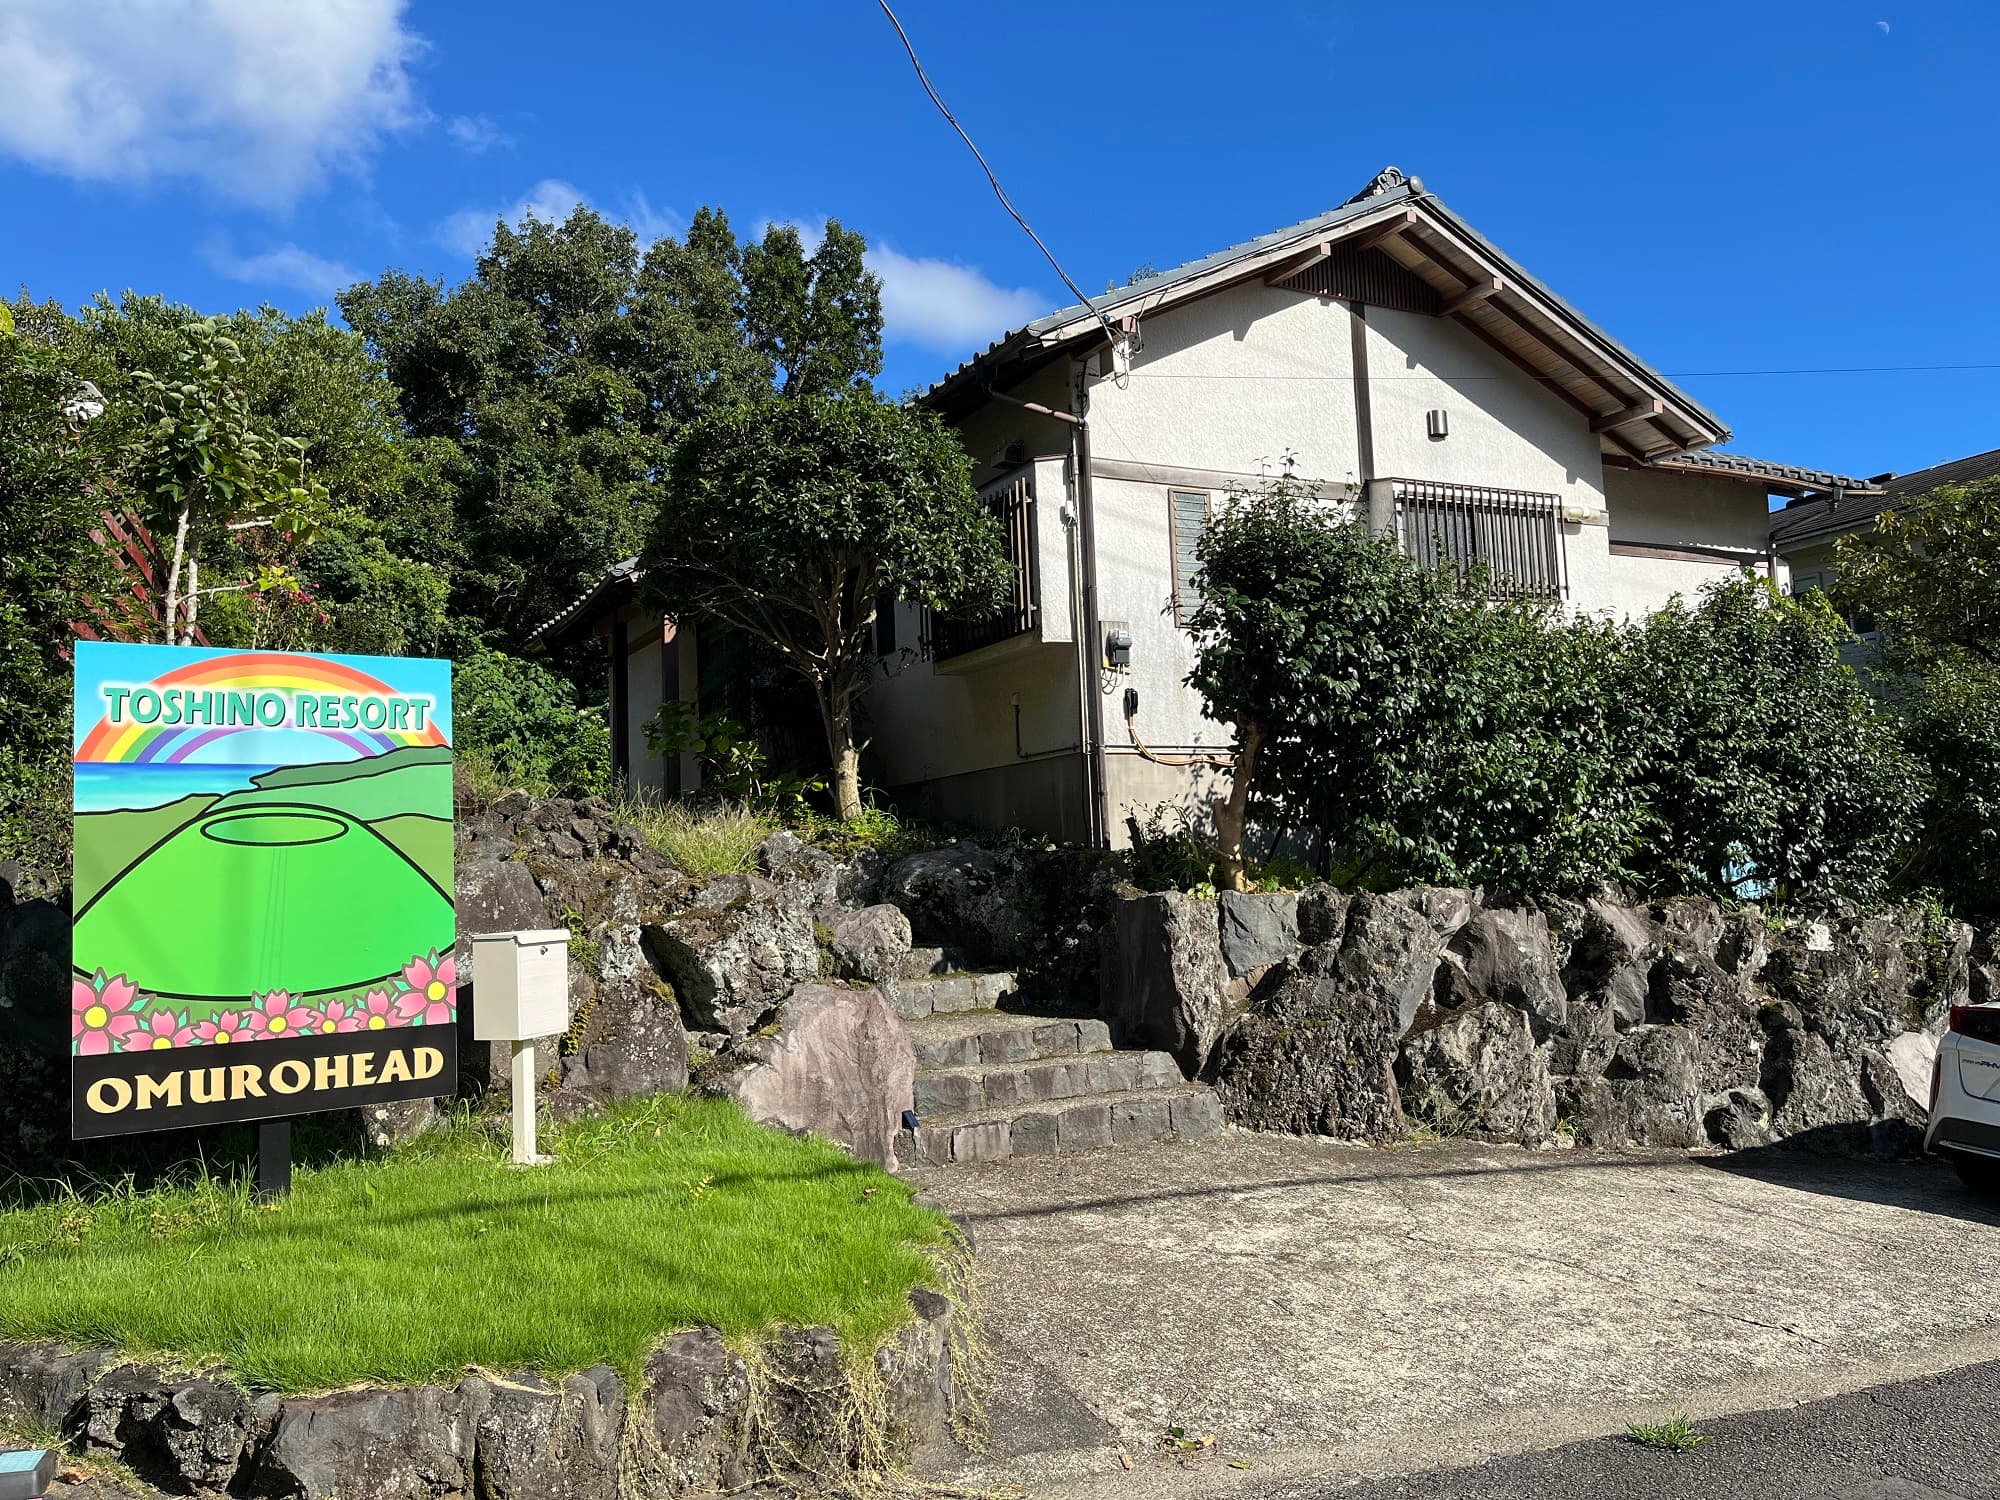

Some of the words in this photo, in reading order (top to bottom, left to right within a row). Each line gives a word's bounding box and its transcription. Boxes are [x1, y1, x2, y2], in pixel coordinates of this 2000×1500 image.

[104, 687, 286, 726] TOSHINO
[295, 694, 430, 730] RESORT
[86, 1047, 444, 1114] OMUROHEAD
